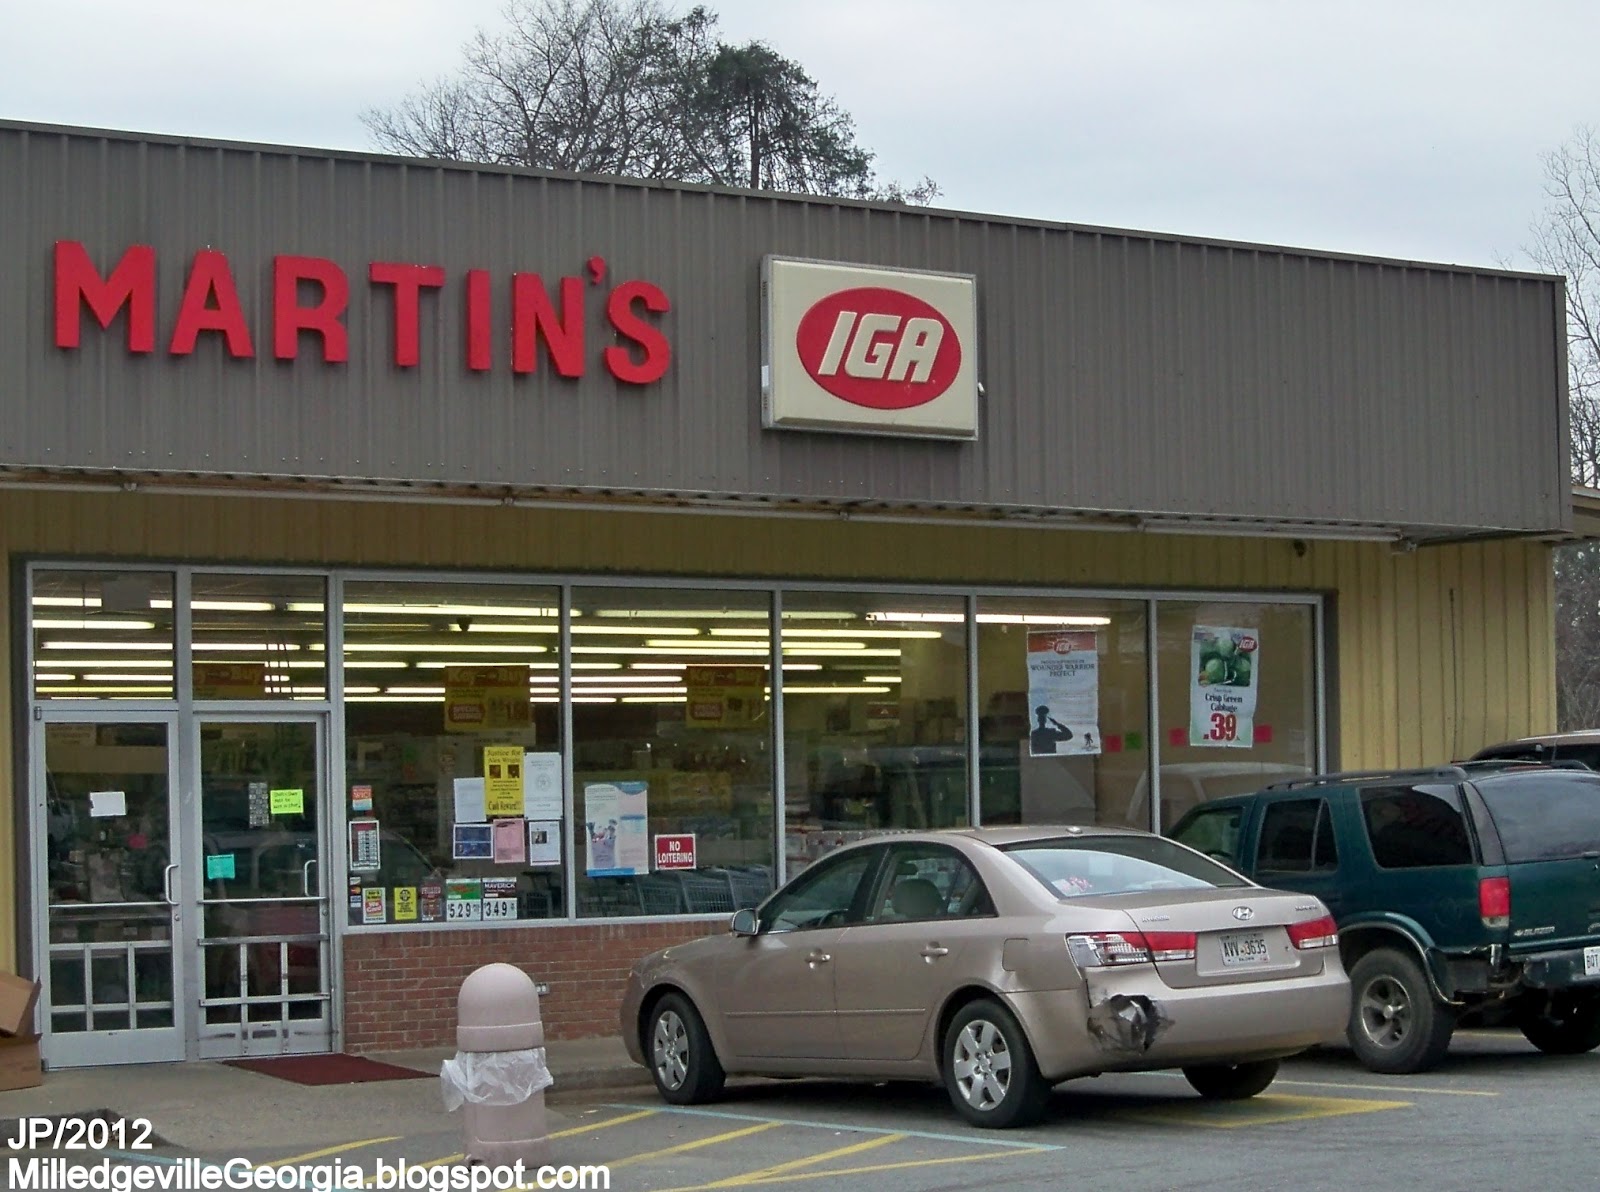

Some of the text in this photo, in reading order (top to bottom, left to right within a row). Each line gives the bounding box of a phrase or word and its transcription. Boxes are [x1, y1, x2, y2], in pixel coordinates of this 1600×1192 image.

[54, 240, 671, 384] MARTIN'S
[818, 311, 945, 384] IGA
[1239, 639, 1255, 649] IGA
[669, 840, 681, 852] NO
[658, 852, 693, 864] LOITERING
